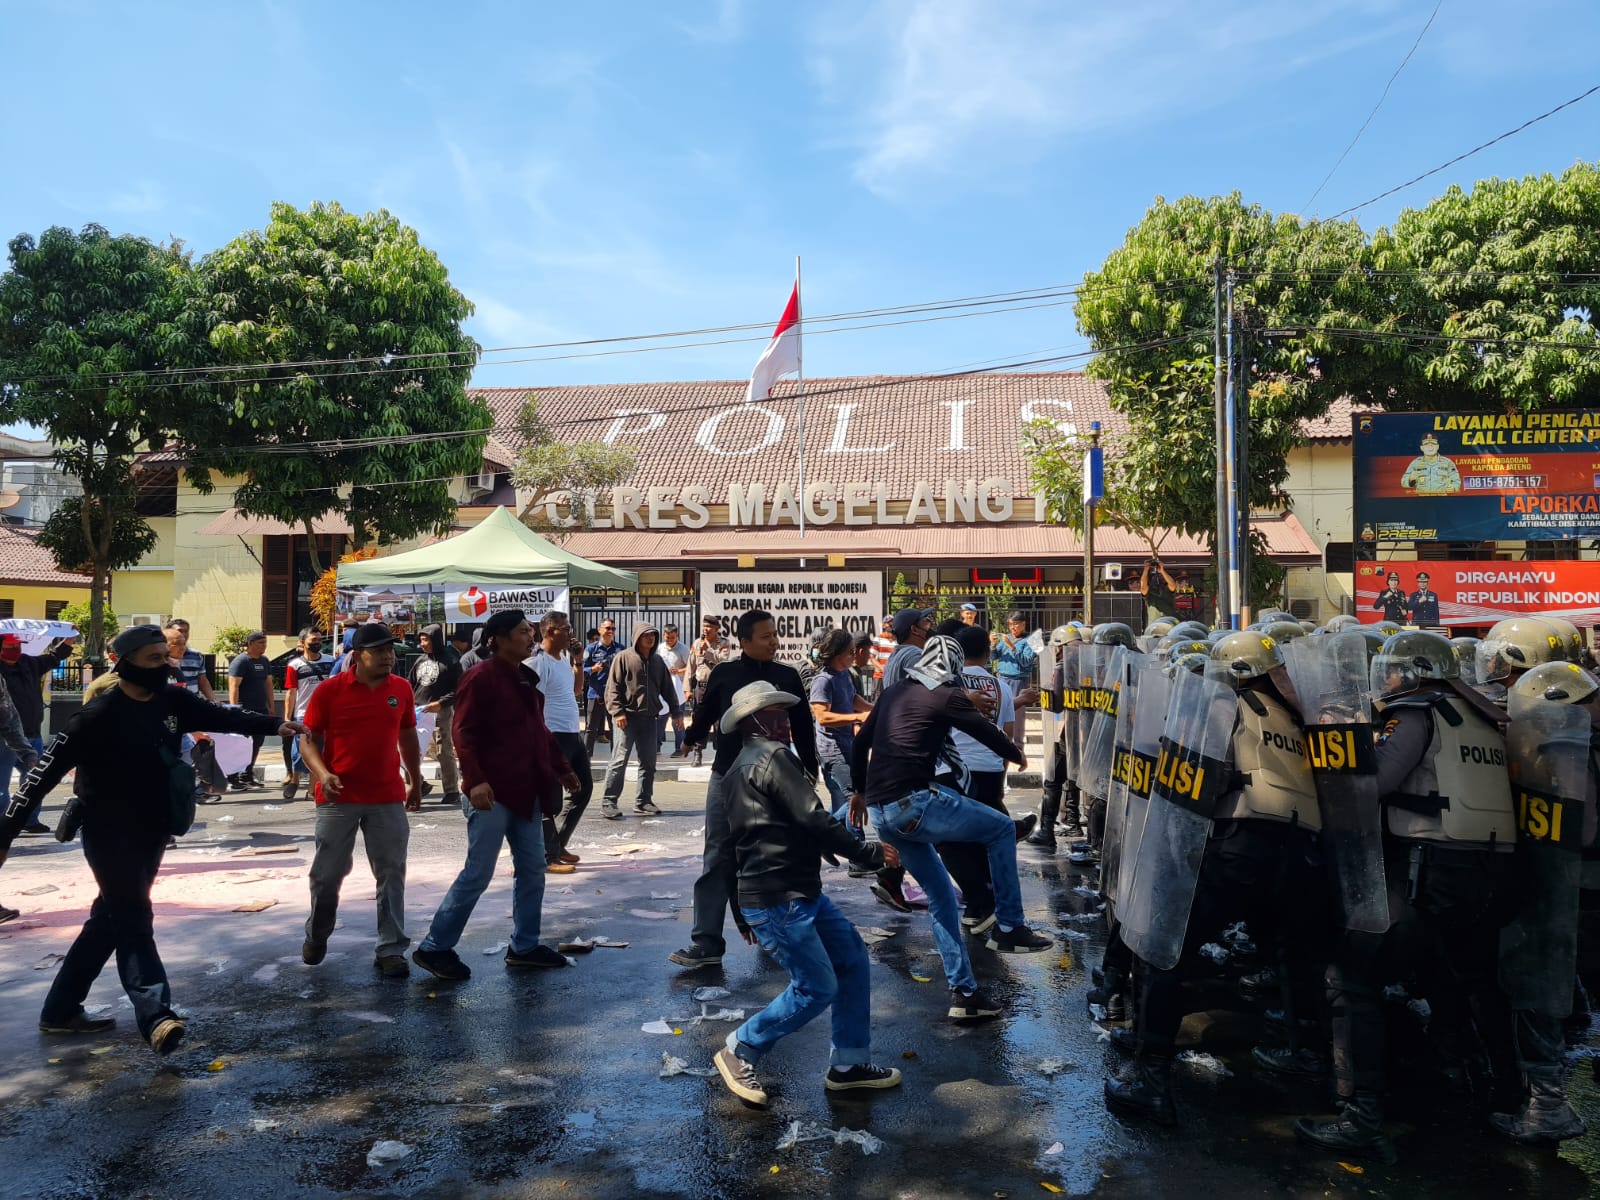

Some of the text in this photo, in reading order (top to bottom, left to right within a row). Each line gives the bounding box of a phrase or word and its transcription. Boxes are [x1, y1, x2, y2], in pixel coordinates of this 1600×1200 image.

[1434, 414, 1522, 430] LAYANAN
[1462, 430, 1507, 445] CALL
[1511, 428, 1582, 444] CENTER
[1506, 463, 1532, 471] JATENG
[1469, 477, 1542, 488] 0815-8751-157
[515, 486, 711, 529] POLRES
[728, 478, 1014, 526] MAGELANG
[1500, 495, 1600, 513] LAPORKA
[1379, 529, 1438, 538] PRESISI
[1455, 571, 1556, 584] DIRGAHAYU
[714, 583, 868, 594] KEPOLISIAN NEGARA REPUBLIK INDONESIA
[489, 591, 555, 604] BAWASLU
[1456, 591, 1541, 604] REPUBLIK
[723, 599, 859, 610] DAERAH JAWA TENGAH
[773, 616, 834, 638] GELANG
[842, 616, 877, 637] KOTA
[1303, 729, 1357, 769] LISI
[1460, 745, 1505, 767] POLISI
